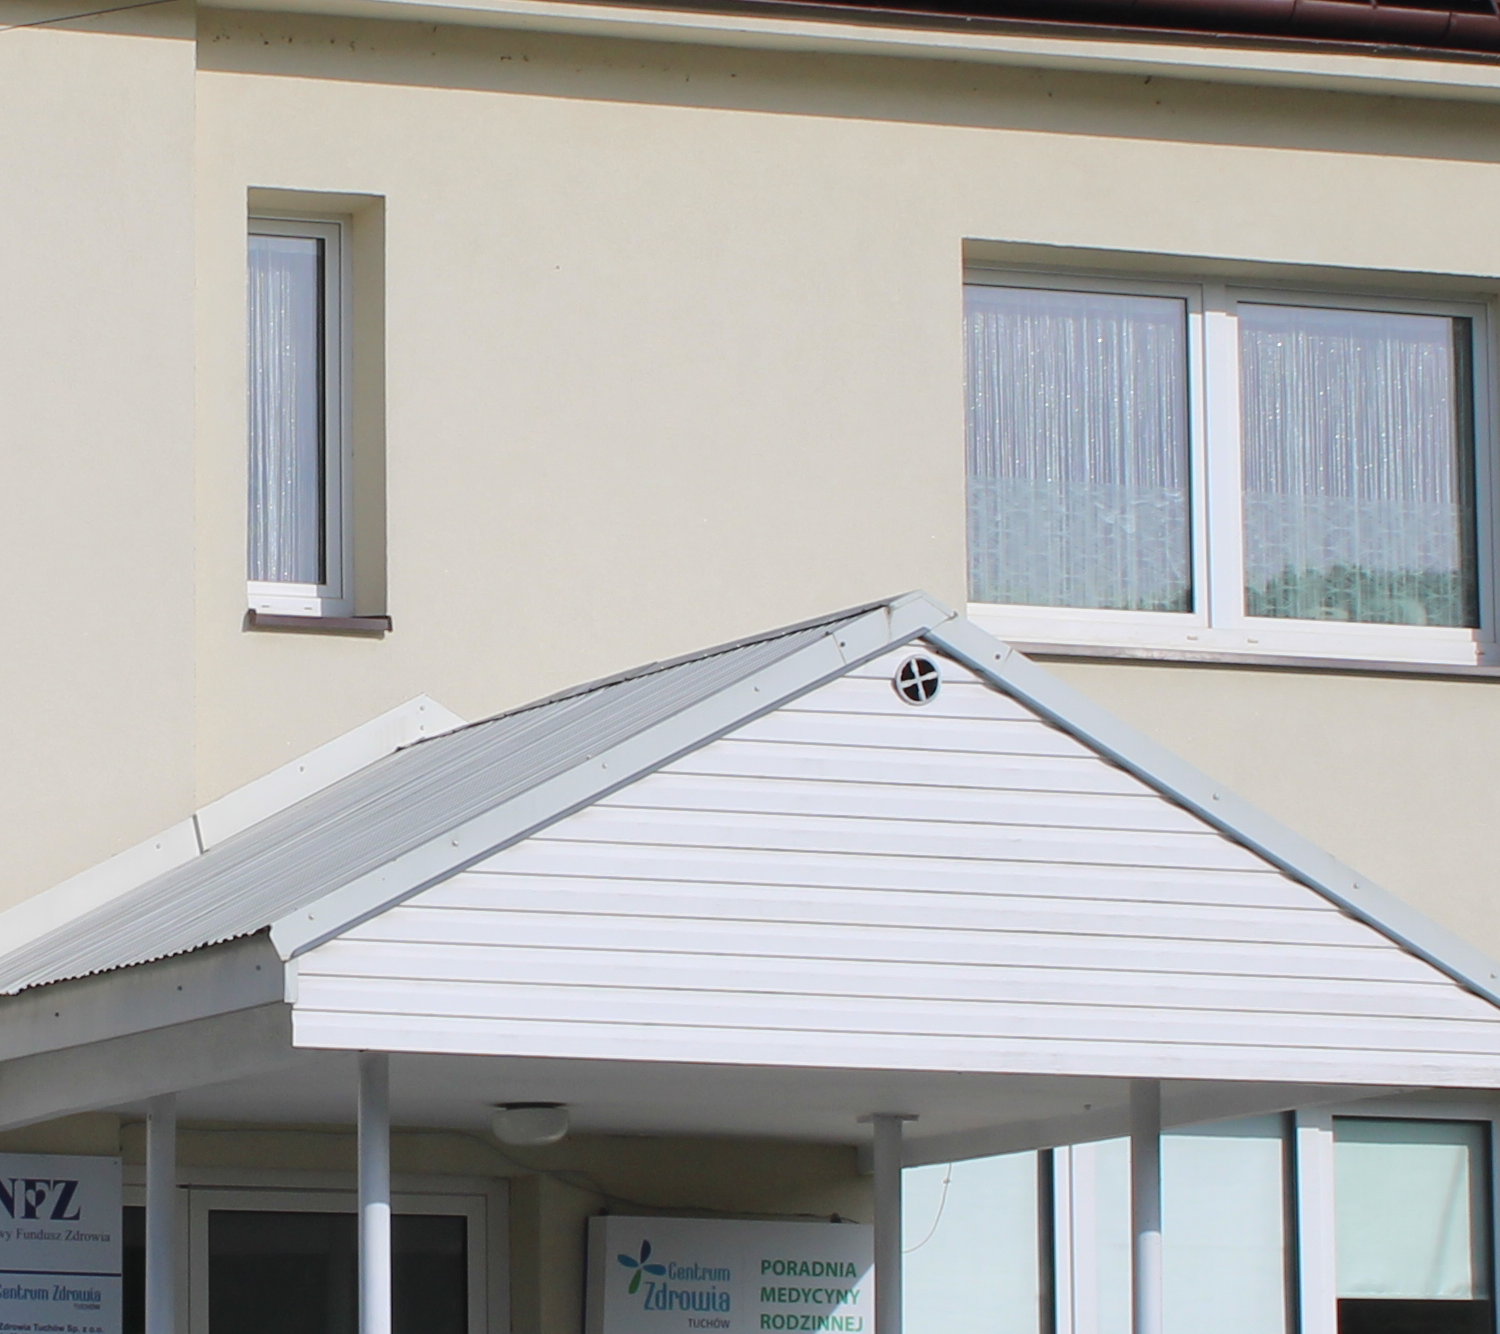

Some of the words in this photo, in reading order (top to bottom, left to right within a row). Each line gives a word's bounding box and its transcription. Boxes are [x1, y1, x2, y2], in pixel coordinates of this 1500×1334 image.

[16, 1228, 62, 1242] Fundusz
[64, 1230, 111, 1244] Zdrowia
[668, 1261, 731, 1282] Centrum
[760, 1259, 857, 1278] PORADNIA
[52, 1285, 102, 1303] Zdrowia
[643, 1281, 731, 1313] Zdrowia
[760, 1286, 861, 1306] MEDYCYNY
[34, 1323, 65, 1332] Tuchów
[688, 1316, 731, 1329] TUCHÓW
[760, 1313, 863, 1333] RODZINNEJ
